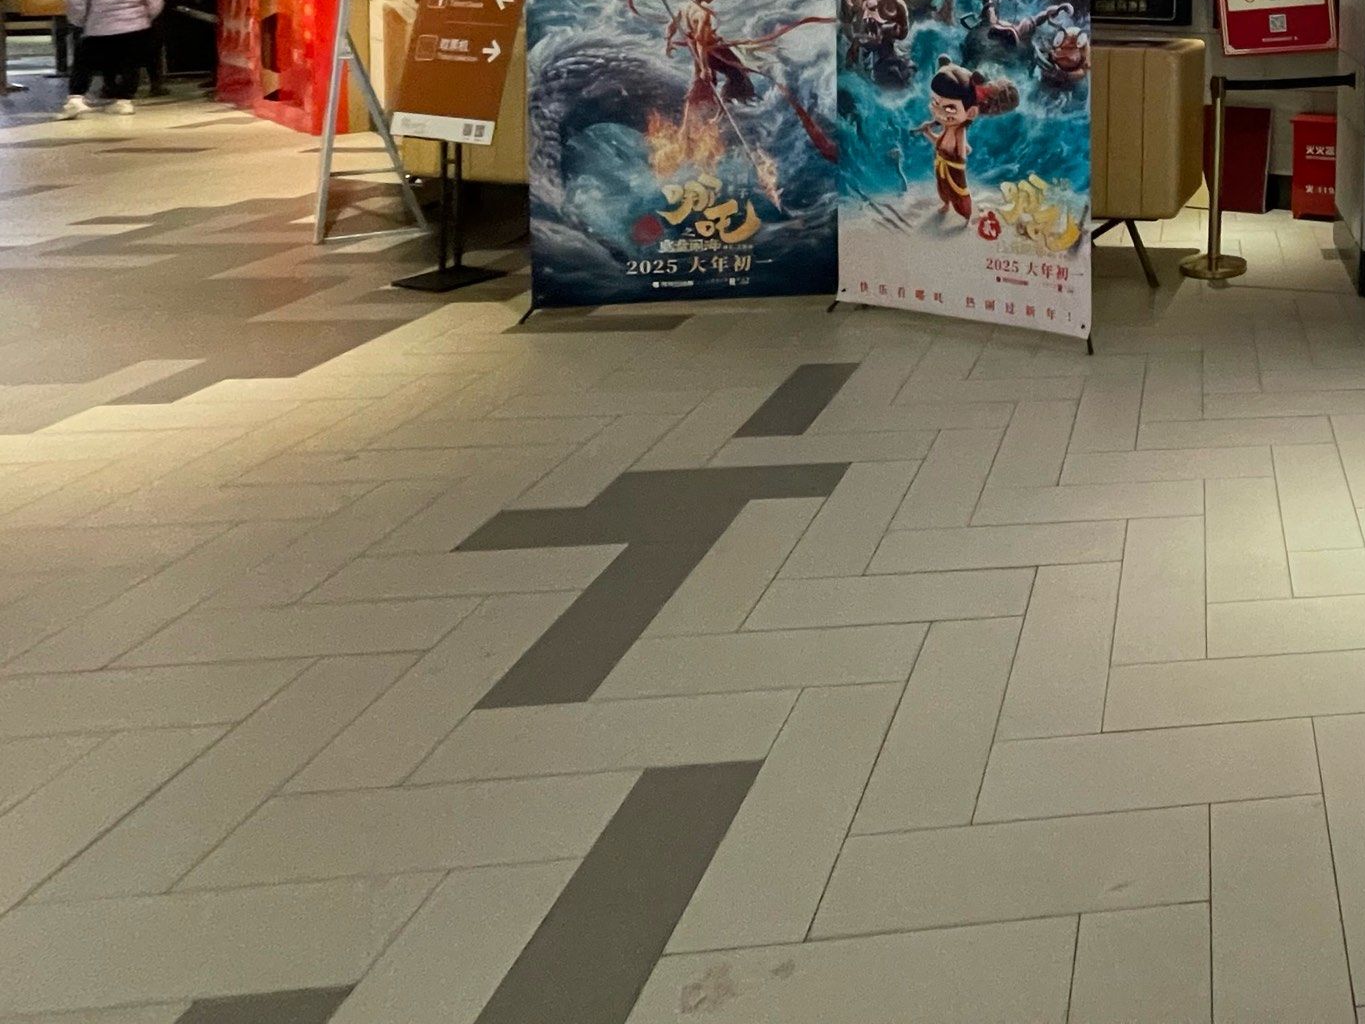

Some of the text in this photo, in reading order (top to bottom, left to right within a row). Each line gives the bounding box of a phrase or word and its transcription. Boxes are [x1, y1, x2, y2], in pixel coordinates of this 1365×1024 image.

[656, 174, 761, 243] 哪吒
[626, 254, 773, 275] 2025 大年初一
[986, 258, 1084, 281] 2025 大年初一
